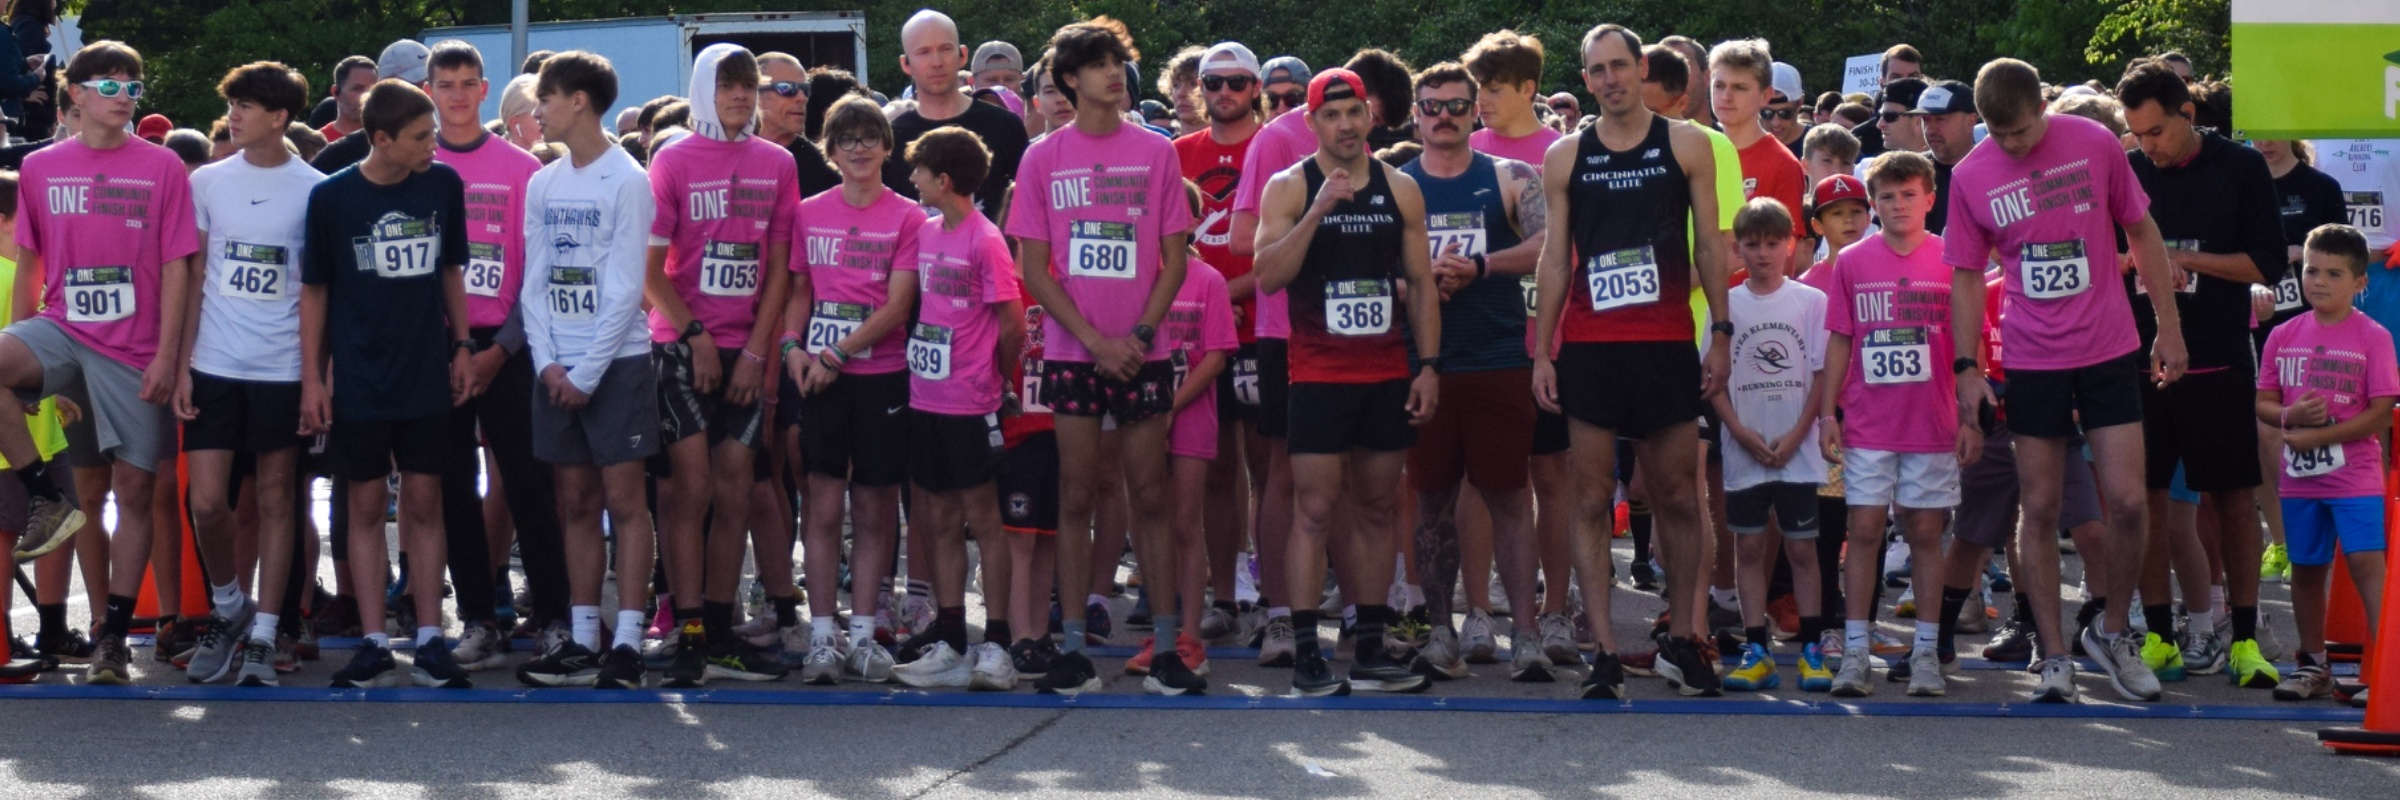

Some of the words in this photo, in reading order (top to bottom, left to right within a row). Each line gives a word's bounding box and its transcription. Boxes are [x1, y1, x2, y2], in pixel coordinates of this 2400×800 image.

[1849, 64, 1873, 76] FINISH
[1582, 166, 1666, 181] CINCINNATUS
[1051, 176, 1092, 210] ONE
[1608, 178, 1643, 190] ELITE
[1833, 177, 1851, 192] A
[48, 185, 89, 214] ONE
[92, 202, 126, 216] FINISH
[690, 188, 728, 221] ONE
[1990, 187, 2035, 228] ONE
[2037, 191, 2071, 213] FINISH
[1084, 221, 1102, 236] ONE
[1319, 213, 1394, 225] INCINNATUS
[1341, 223, 1373, 233] ELITE
[1431, 214, 1448, 228] ONE
[385, 222, 403, 238] ONE
[236, 243, 253, 258] ONE
[717, 242, 735, 257] ONE
[807, 235, 842, 266] ONE
[1428, 233, 1475, 261] 747
[2032, 244, 2049, 257] ONE
[385, 242, 429, 272] 917
[1079, 243, 1128, 272] 680
[1600, 252, 1618, 268] ONE
[76, 268, 95, 283] ONE
[229, 265, 278, 294] 462
[462, 263, 501, 290] 36
[705, 263, 758, 289] 1053
[1592, 268, 1658, 302] 2053
[2030, 263, 2080, 292] 523
[1338, 281, 1357, 295] ONE
[74, 288, 122, 316] 901
[549, 288, 596, 314] 1614
[823, 301, 840, 315] ONE
[1855, 291, 1894, 322] ONE
[1336, 301, 1384, 329] 368
[1874, 329, 1893, 344] ONE
[910, 344, 942, 374] 339
[1871, 349, 1922, 378] 363
[1741, 381, 1783, 392] RUNNING
[2307, 375, 2336, 390] FINISH
